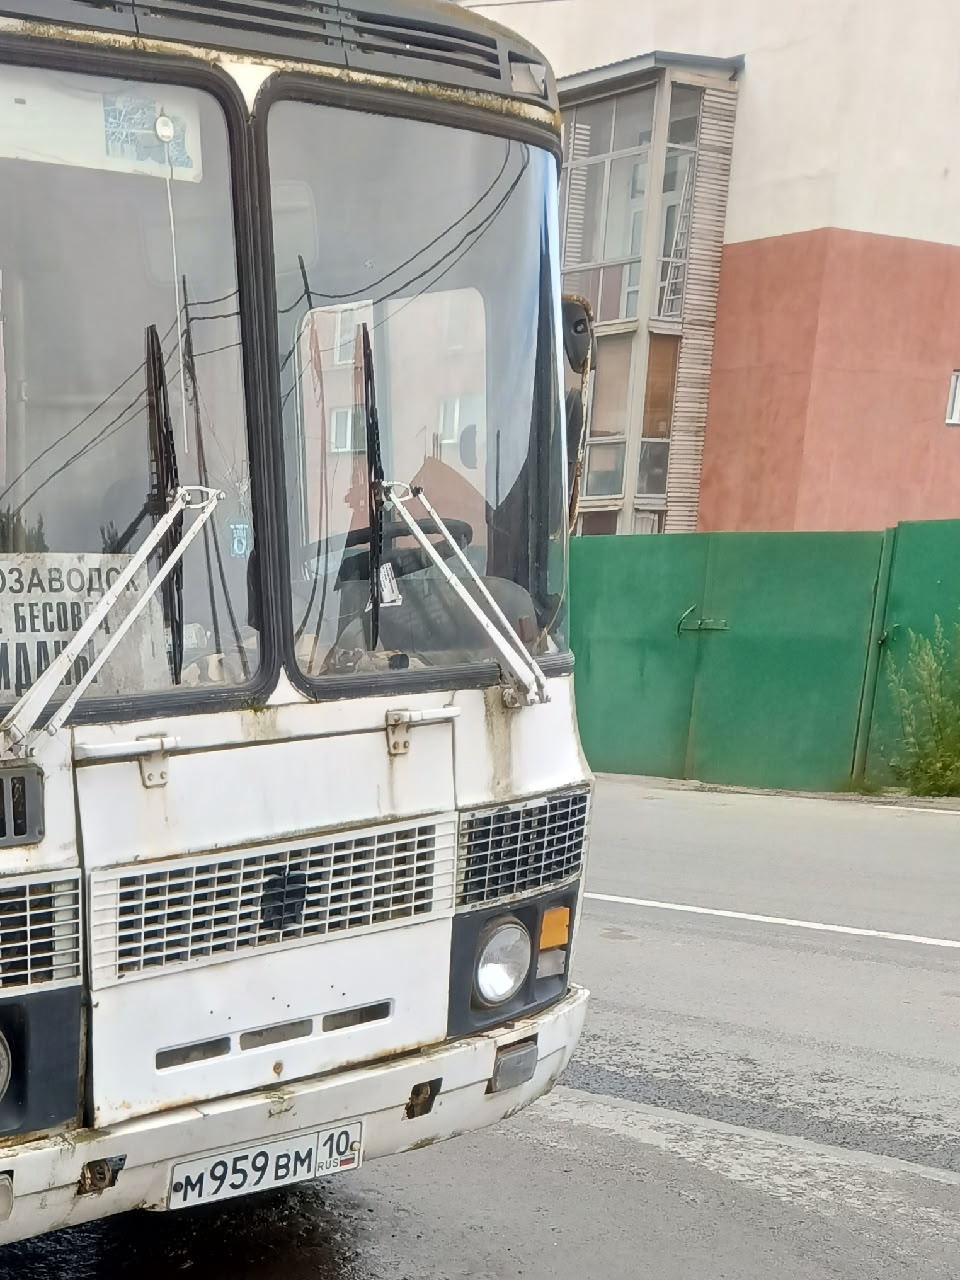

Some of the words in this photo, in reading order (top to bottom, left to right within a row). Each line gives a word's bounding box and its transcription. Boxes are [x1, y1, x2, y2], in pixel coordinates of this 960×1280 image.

[182, 1147, 313, 1202] М959ВМ
[322, 1130, 350, 1159] 10
[317, 1158, 339, 1172] RUS
